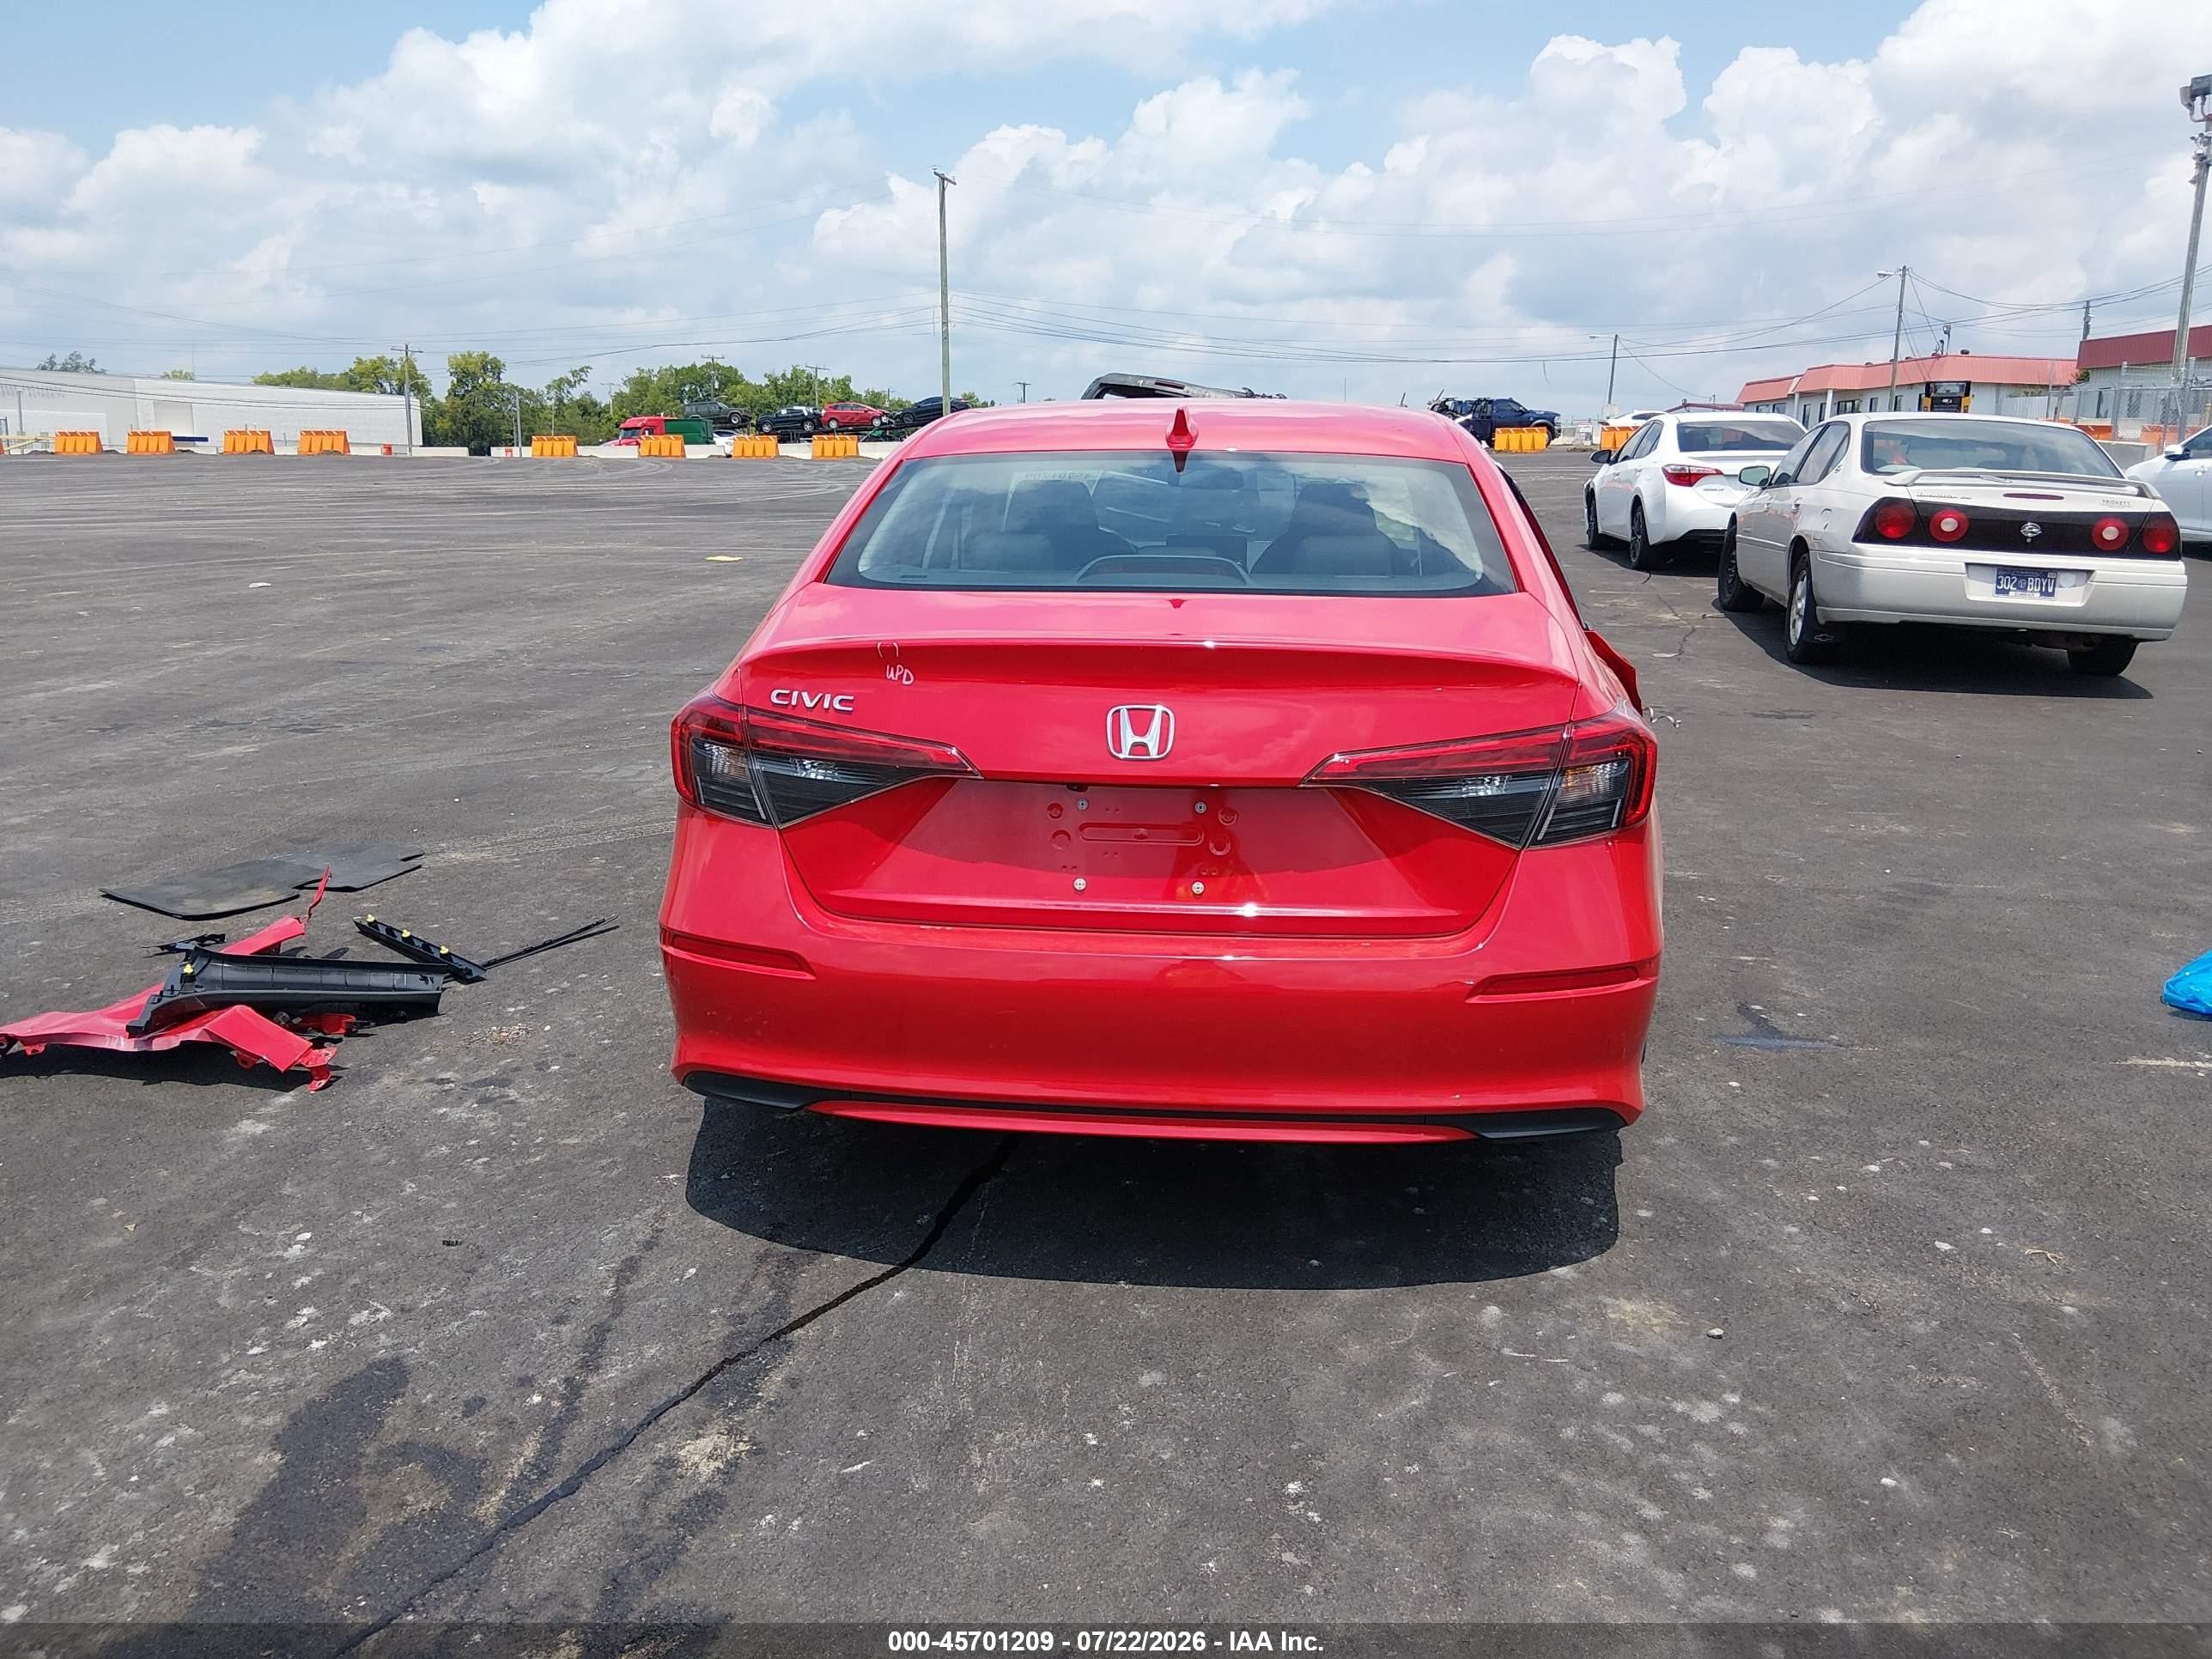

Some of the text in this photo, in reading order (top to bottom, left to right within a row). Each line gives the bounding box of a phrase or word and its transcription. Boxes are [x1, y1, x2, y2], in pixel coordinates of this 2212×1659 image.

[1996, 575, 2055, 592] 302 BDYV
[770, 689, 855, 712] CIVIC
